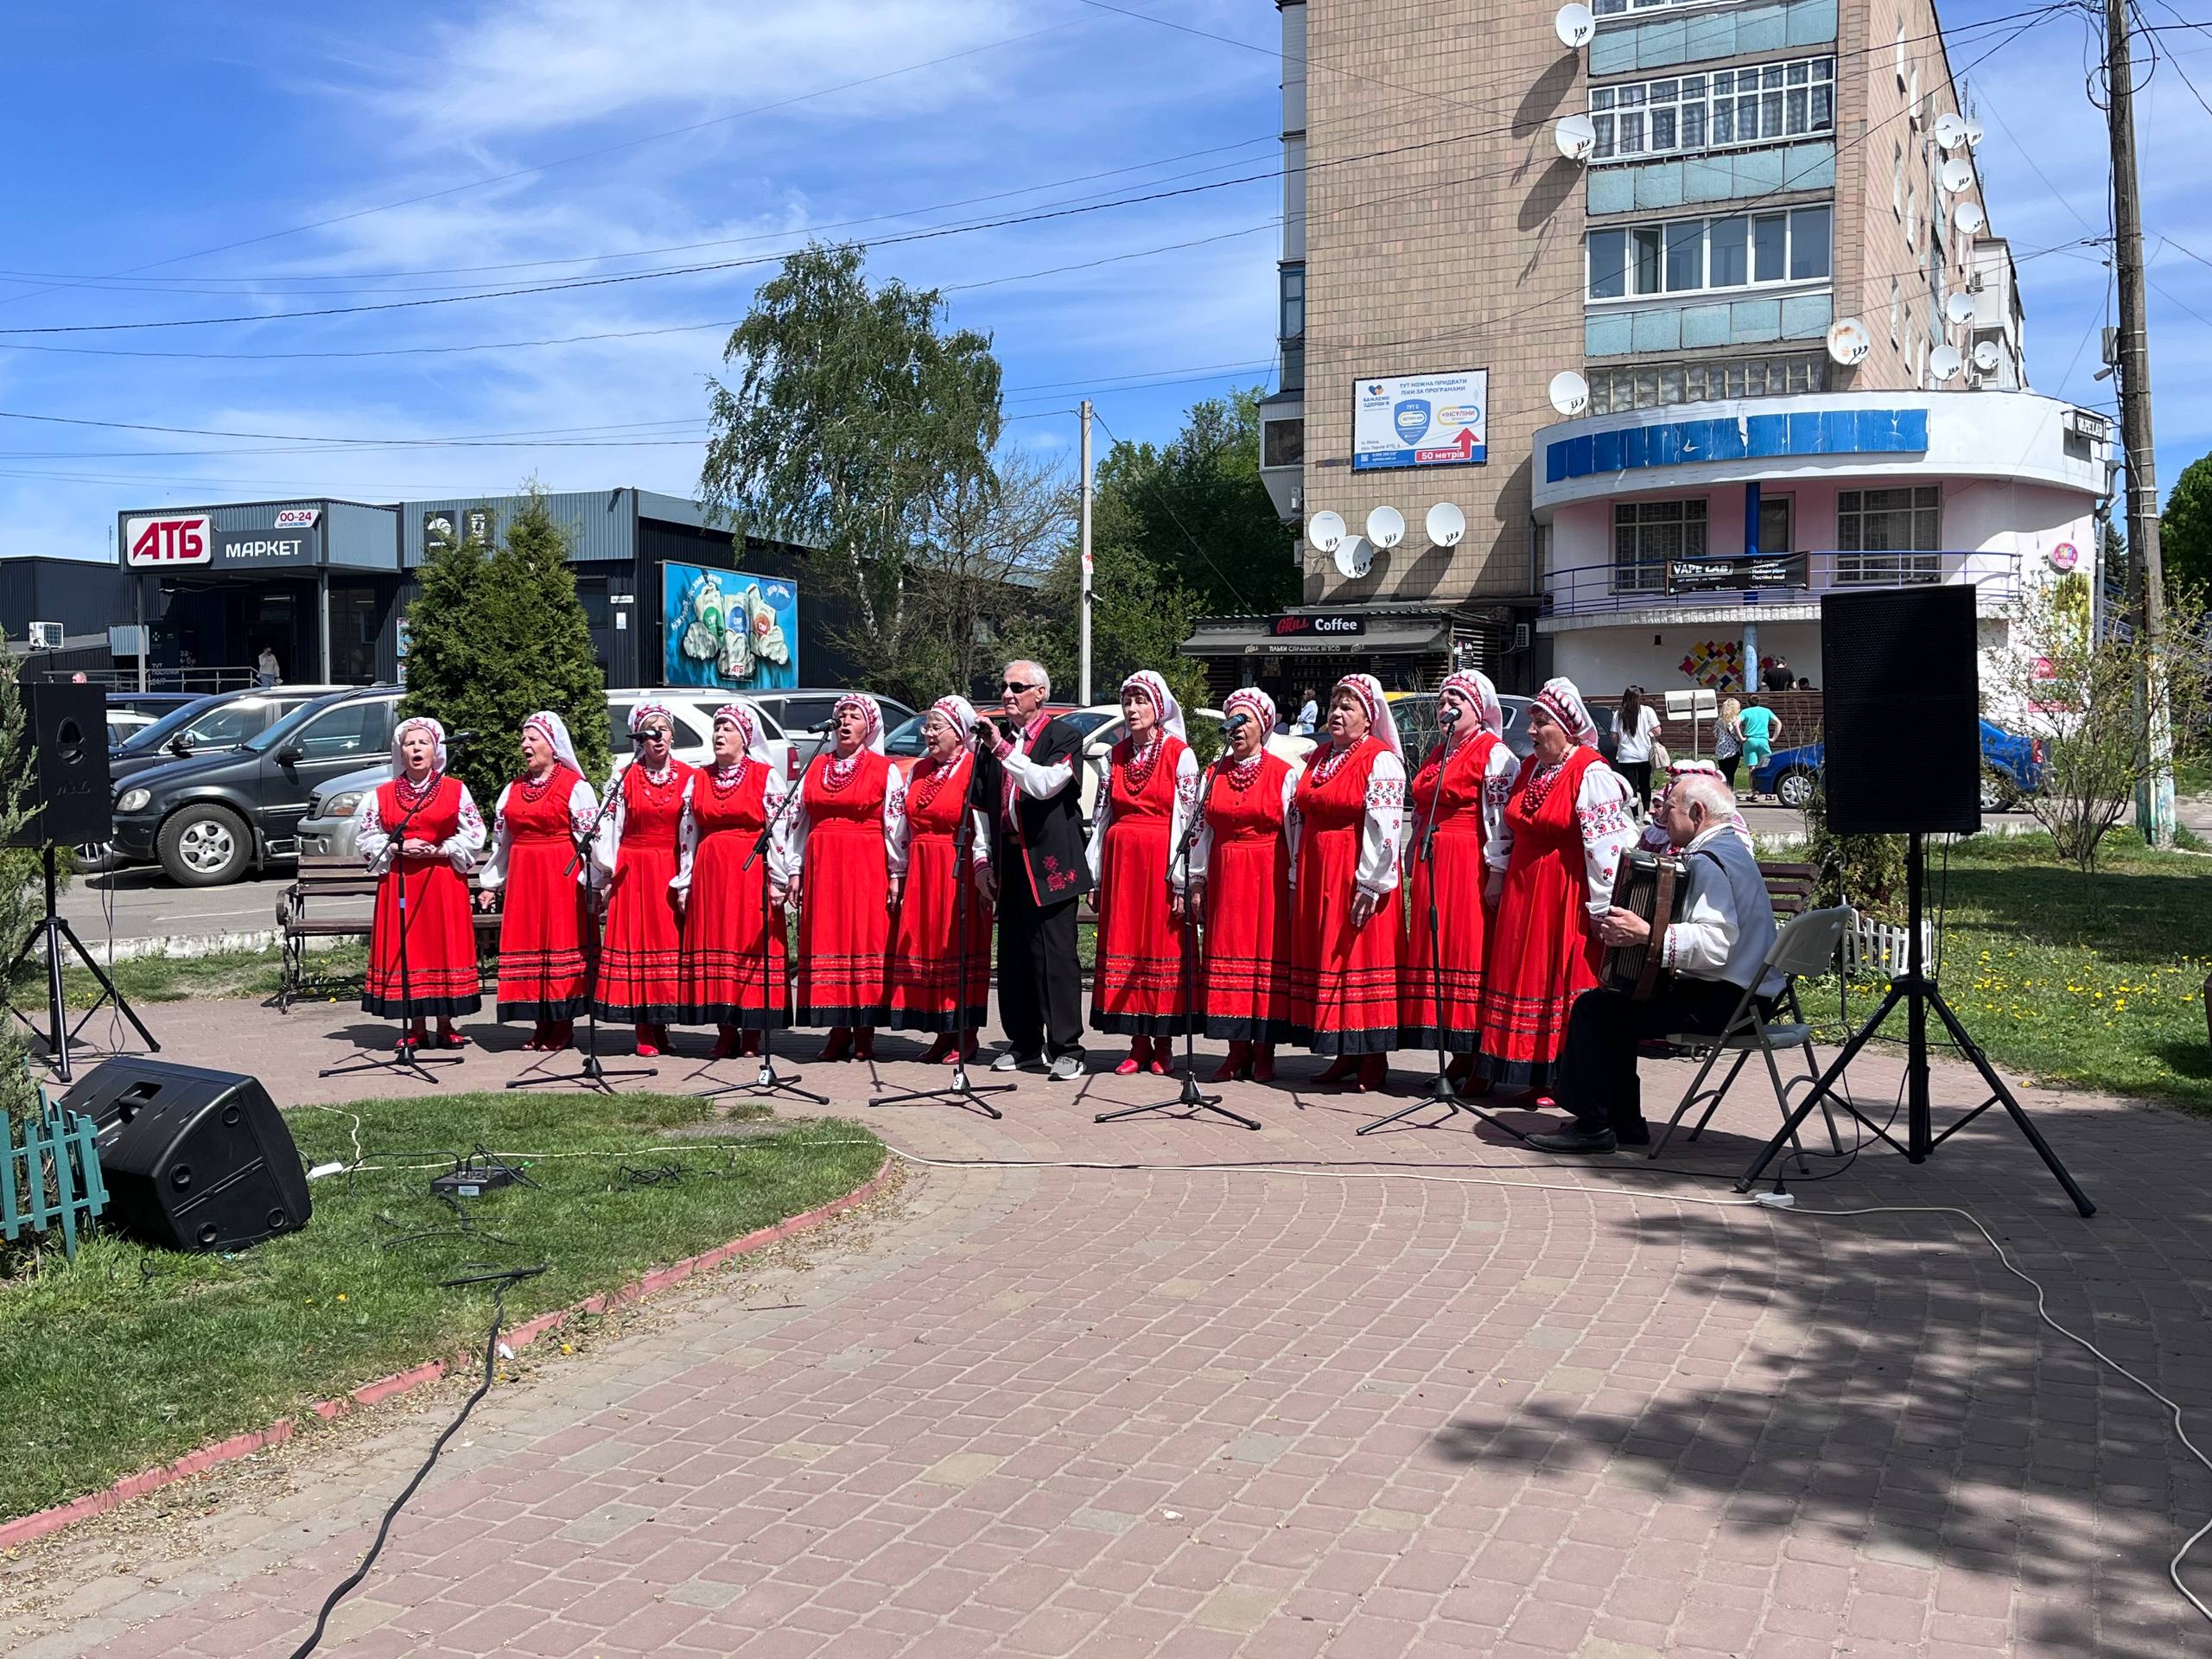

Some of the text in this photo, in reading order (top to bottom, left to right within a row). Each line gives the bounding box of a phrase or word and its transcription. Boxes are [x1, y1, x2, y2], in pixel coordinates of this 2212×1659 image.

[1435, 452, 1465, 461] метрів
[280, 512, 312, 522] 00-24
[133, 519, 205, 561] АТБ
[226, 539, 302, 558] МАРКЕТ
[1674, 563, 1703, 575] VAPE
[1314, 618, 1357, 631] Coffee
[732, 664, 745, 674] АТБ
